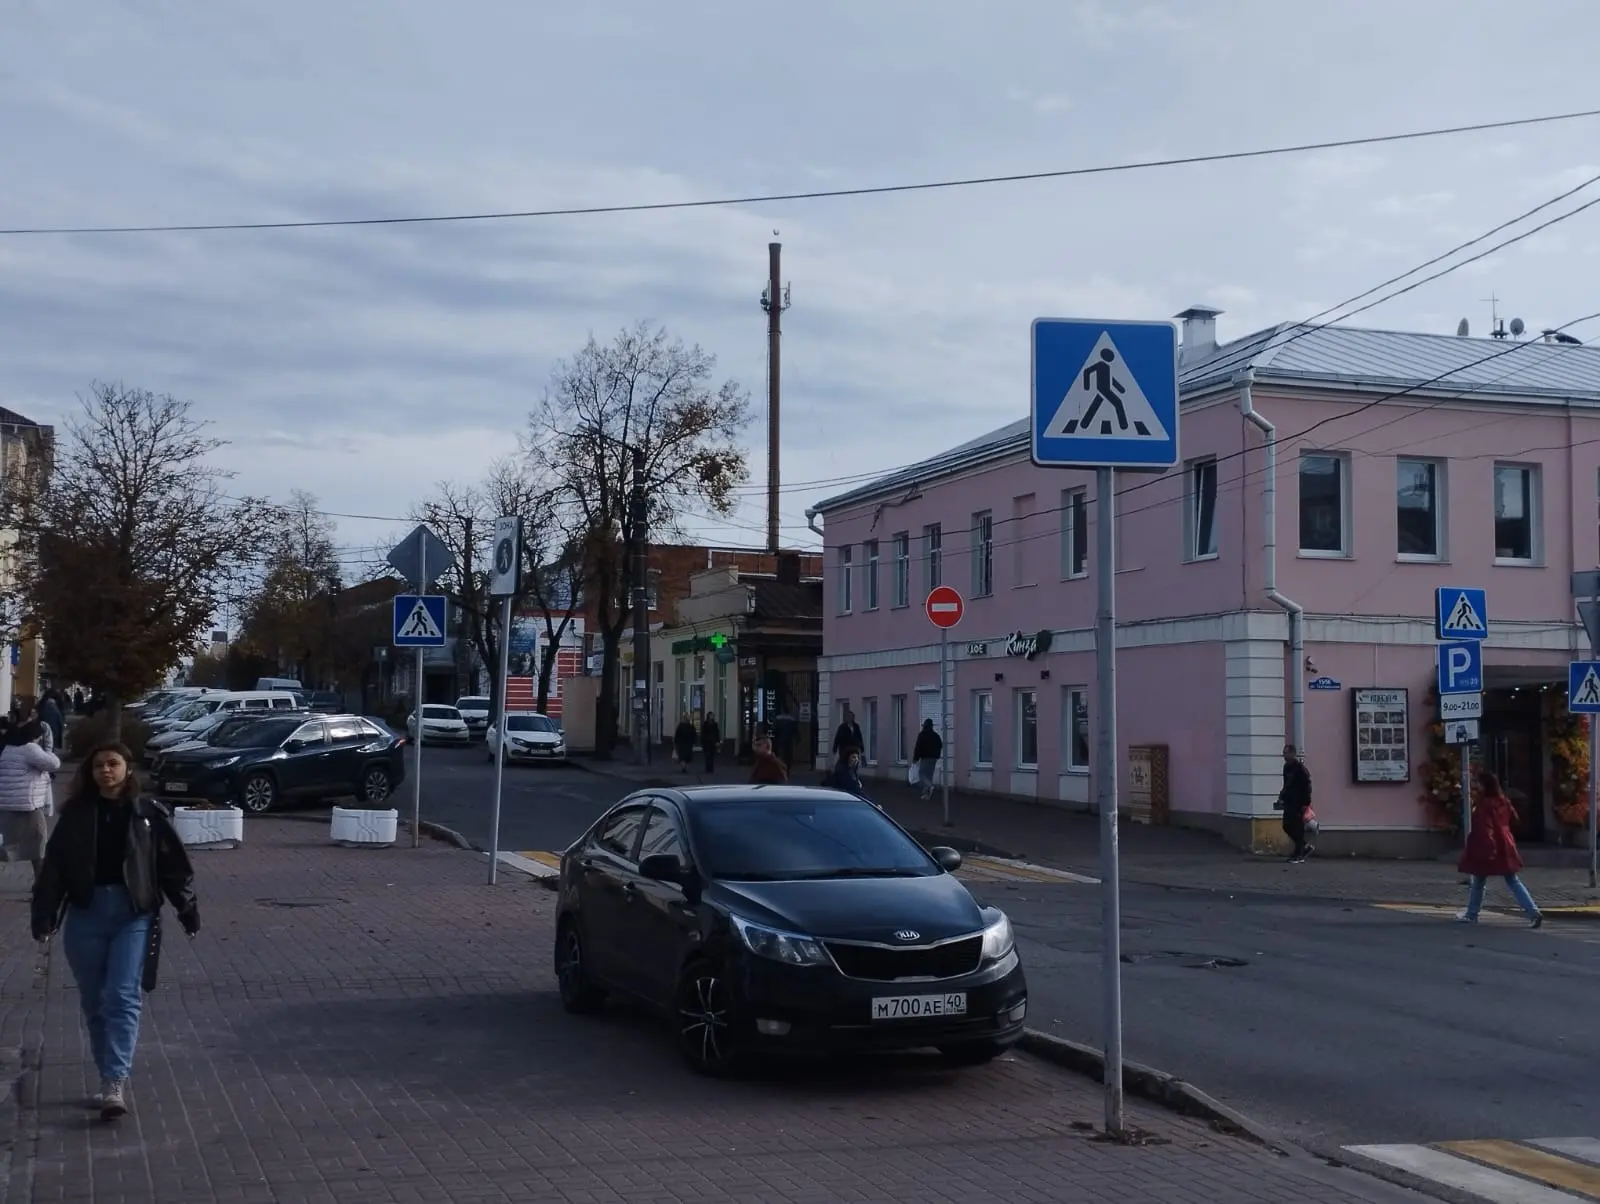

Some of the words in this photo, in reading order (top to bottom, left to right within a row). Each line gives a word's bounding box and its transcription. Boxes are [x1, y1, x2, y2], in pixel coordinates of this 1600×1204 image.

[1448, 647, 1471, 687] P
[878, 999, 941, 1016] М700АЕ
[947, 995, 961, 1008] 40
